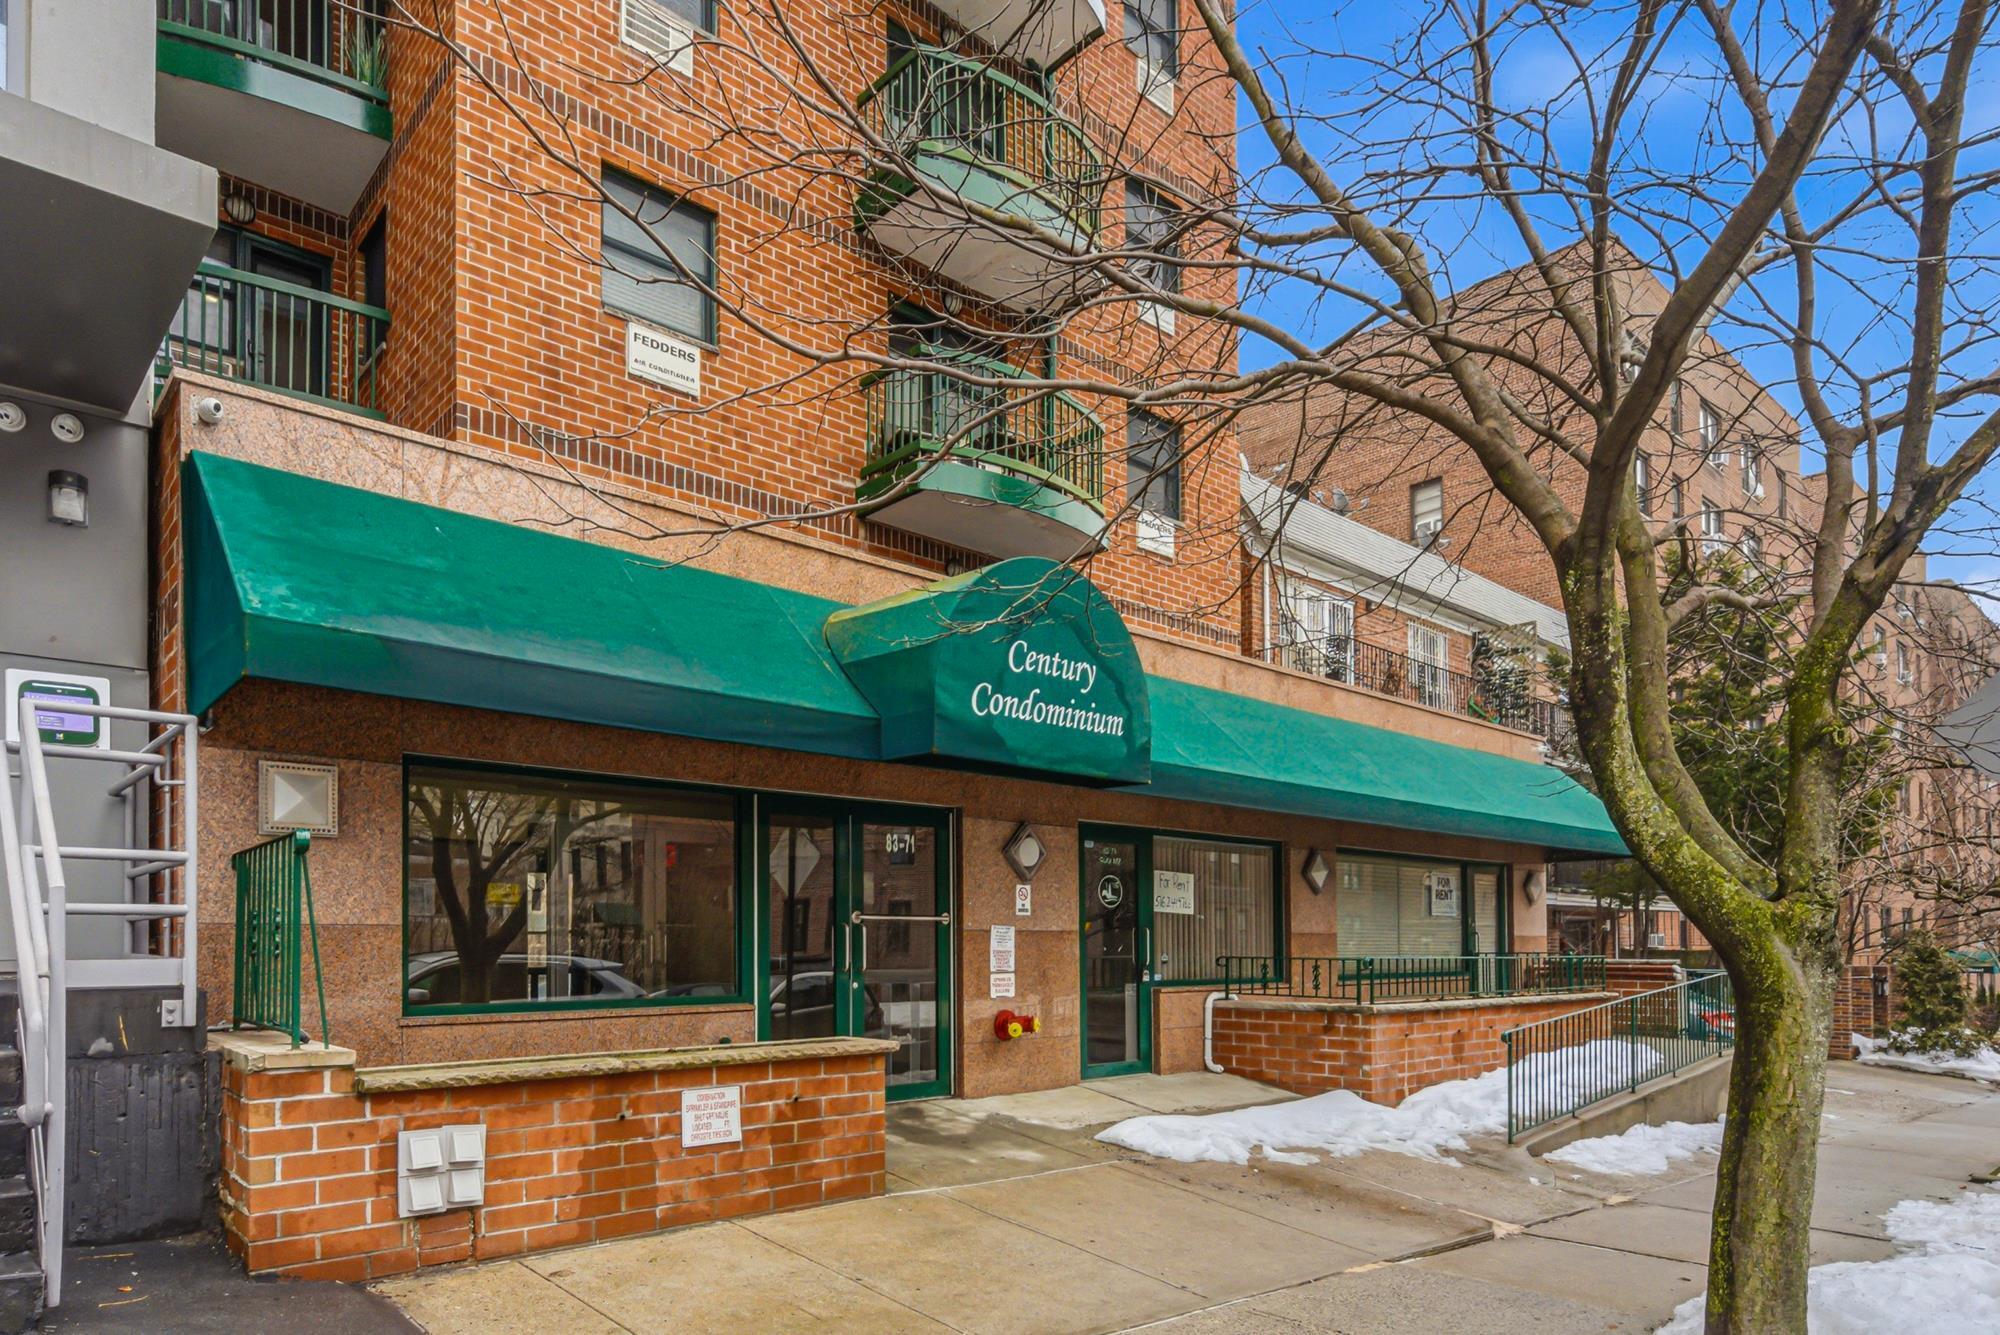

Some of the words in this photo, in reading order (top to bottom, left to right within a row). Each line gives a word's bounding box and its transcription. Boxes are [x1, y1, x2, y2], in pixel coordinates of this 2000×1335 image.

[634, 332, 696, 364] FEDDERS
[1008, 640, 1097, 694] Century
[971, 682, 1124, 736] Condominium
[886, 833, 915, 854] 83-71
[1436, 889, 1453, 900] RENT
[1437, 877, 1450, 888] FOR
